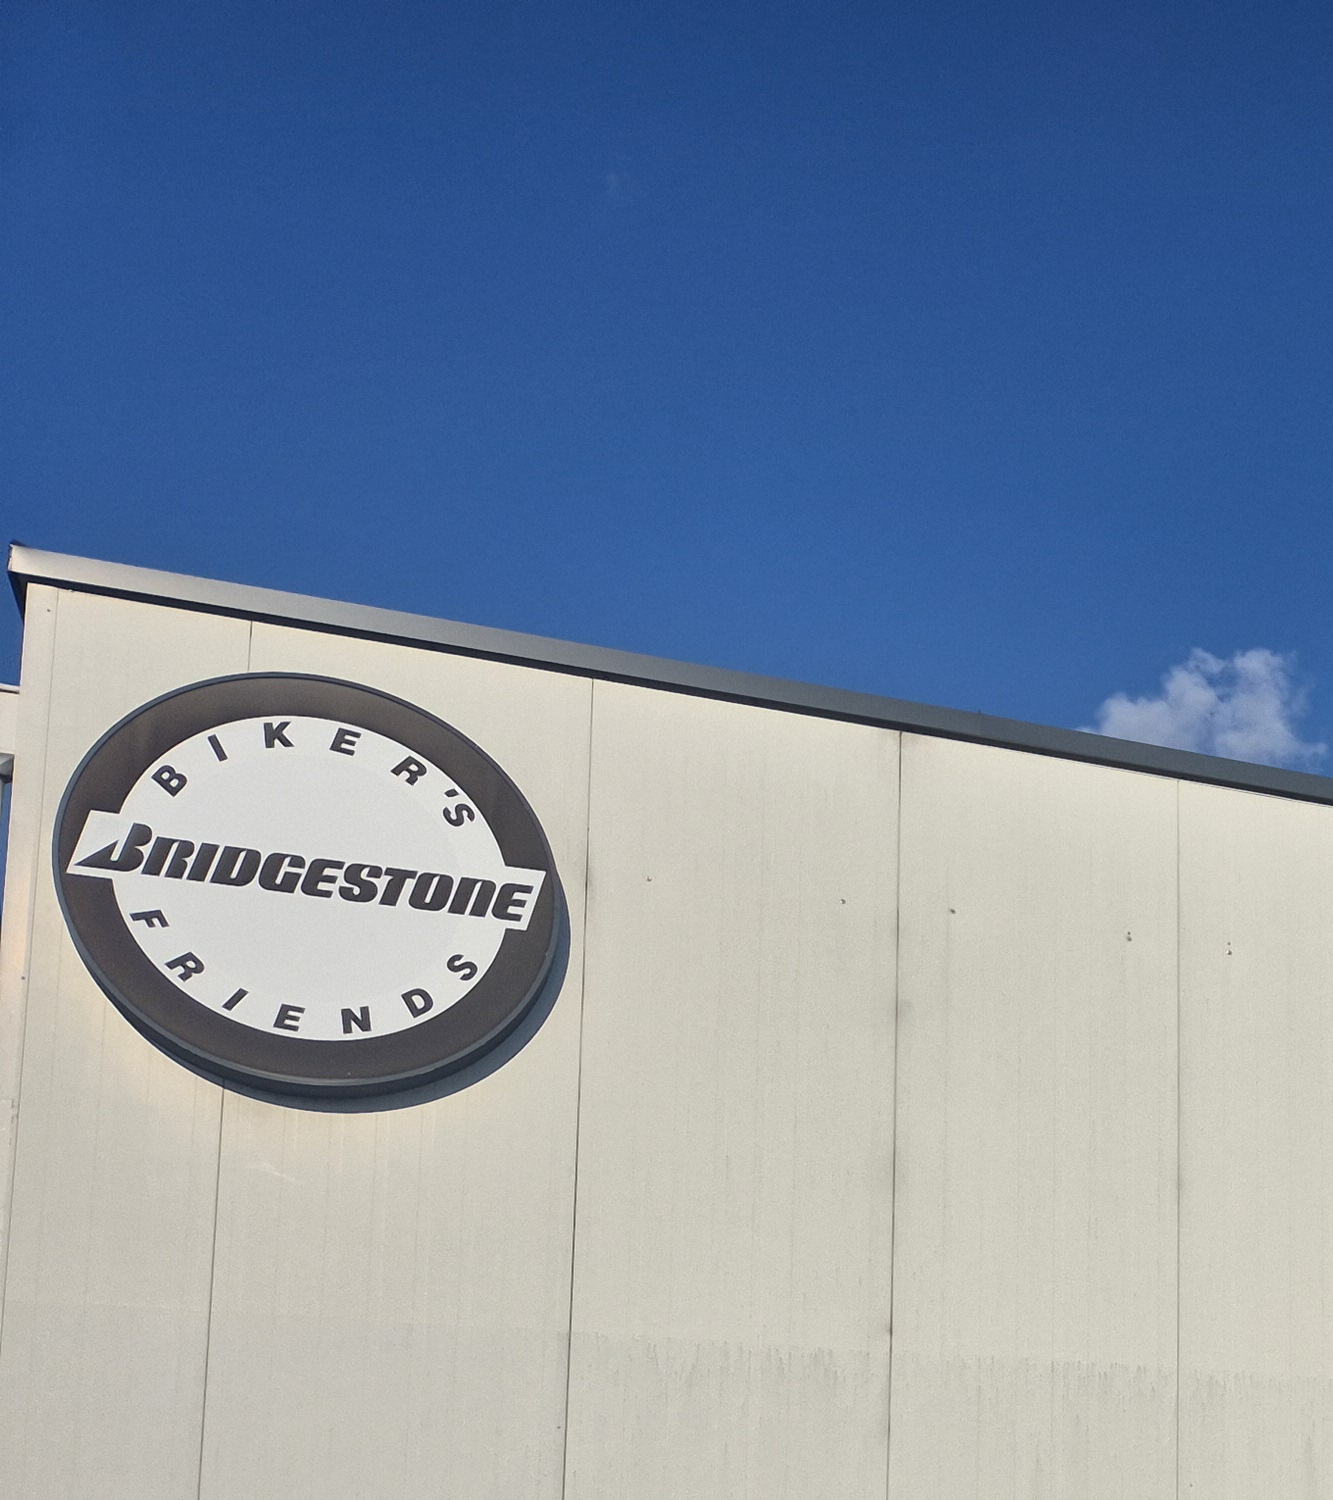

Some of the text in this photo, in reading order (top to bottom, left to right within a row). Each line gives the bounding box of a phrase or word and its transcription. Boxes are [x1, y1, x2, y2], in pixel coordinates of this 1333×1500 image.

[151, 720, 476, 828] BIKER'S
[74, 822, 533, 923] BRIDGESTONE
[132, 908, 479, 1035] FRIENDS
